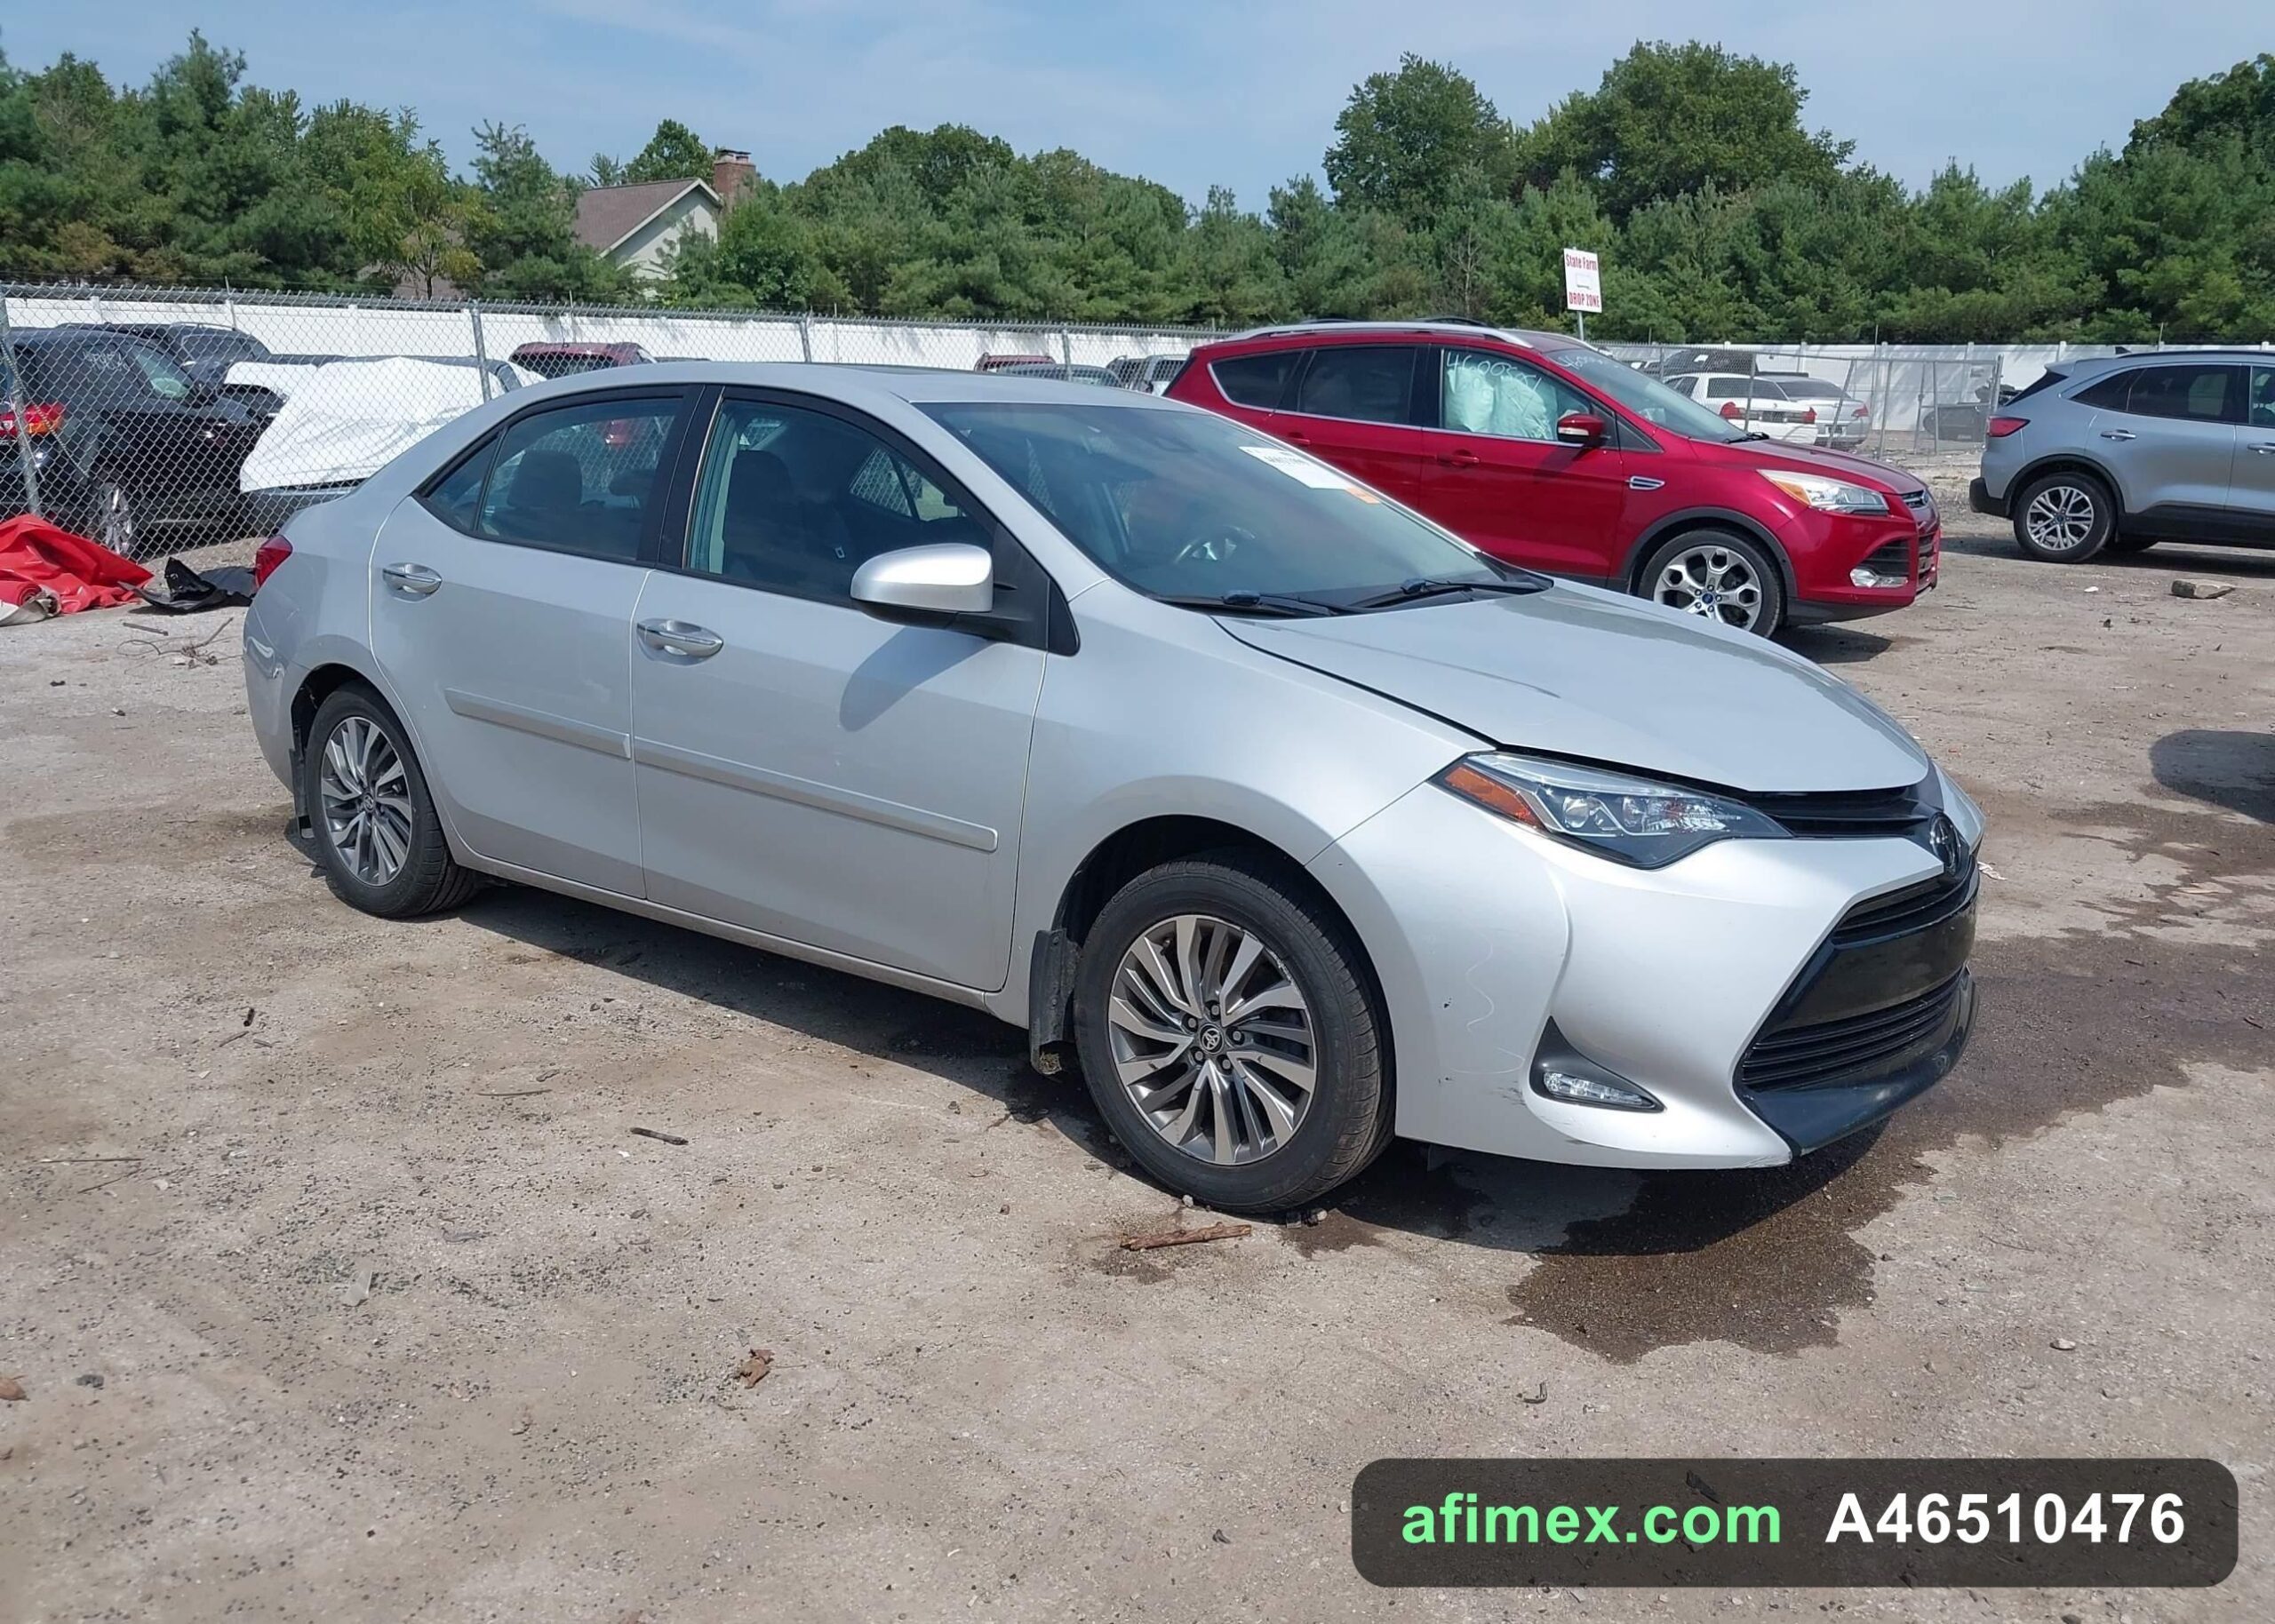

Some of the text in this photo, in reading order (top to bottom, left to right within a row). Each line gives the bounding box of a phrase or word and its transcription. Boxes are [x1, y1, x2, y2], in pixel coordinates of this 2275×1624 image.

[1566, 253, 1598, 271] State Farm
[1569, 291, 1600, 308] DROP ZONE
